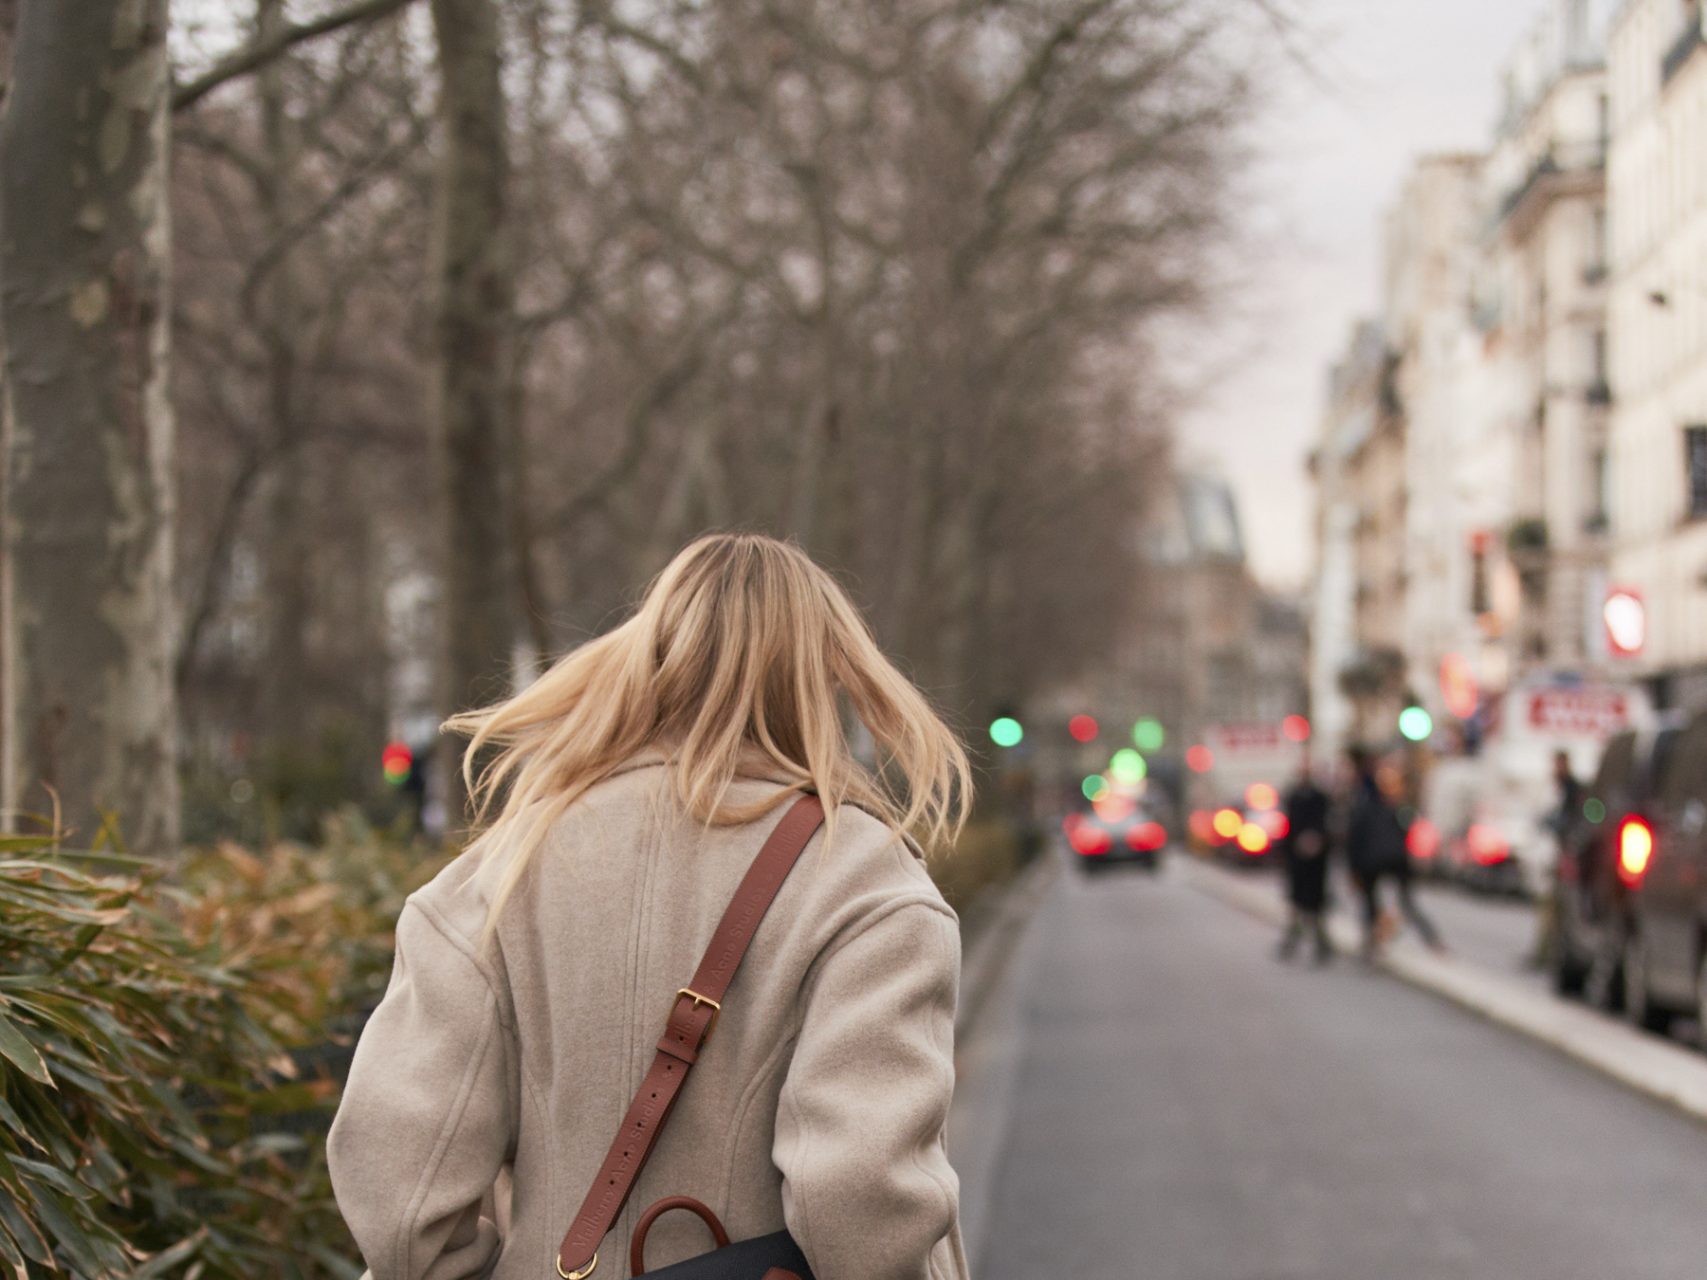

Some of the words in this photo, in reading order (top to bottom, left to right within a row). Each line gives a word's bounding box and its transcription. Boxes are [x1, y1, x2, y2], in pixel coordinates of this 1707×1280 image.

[710, 940, 737, 979] Acne
[729, 886, 766, 938] Studios
[571, 1187, 614, 1247] Mulberry
